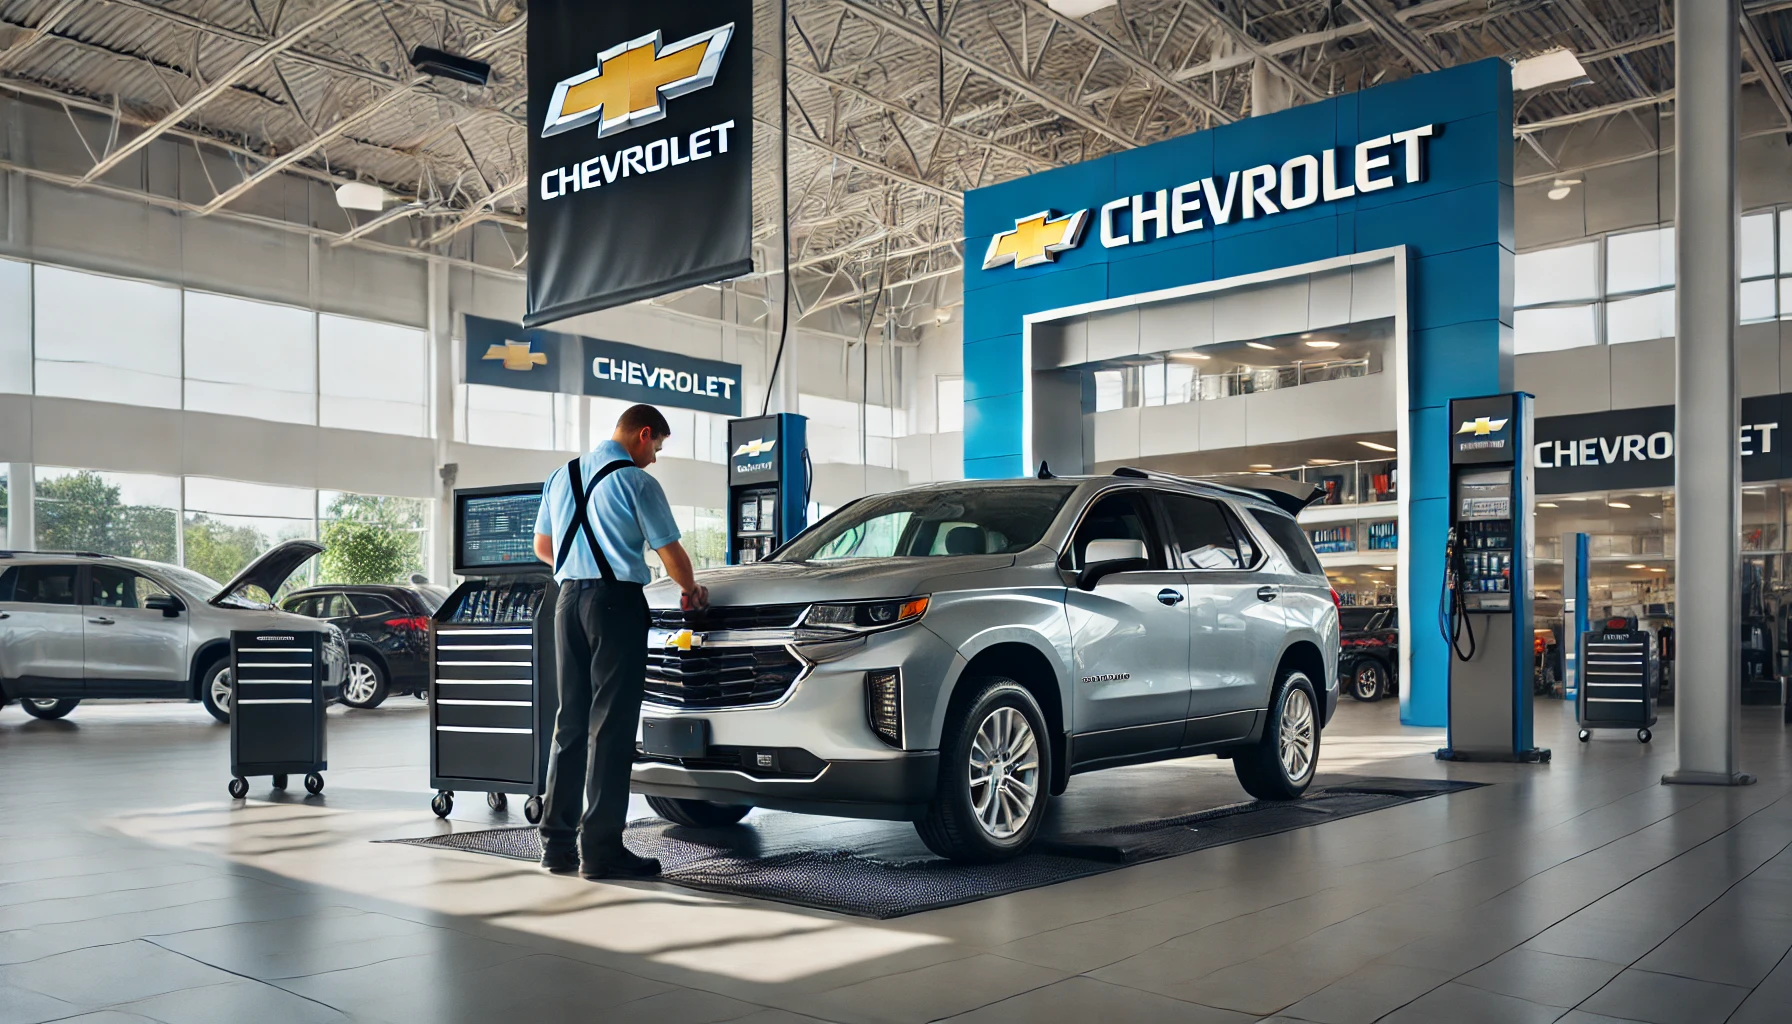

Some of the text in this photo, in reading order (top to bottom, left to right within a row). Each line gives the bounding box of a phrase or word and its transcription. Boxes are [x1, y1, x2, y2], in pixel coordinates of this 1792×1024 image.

[541, 119, 735, 201] CHEVROLET
[1100, 124, 1433, 249] CHEVROLET
[592, 356, 736, 400] CHEVROLET
[1534, 422, 1779, 469] CHEVROET
